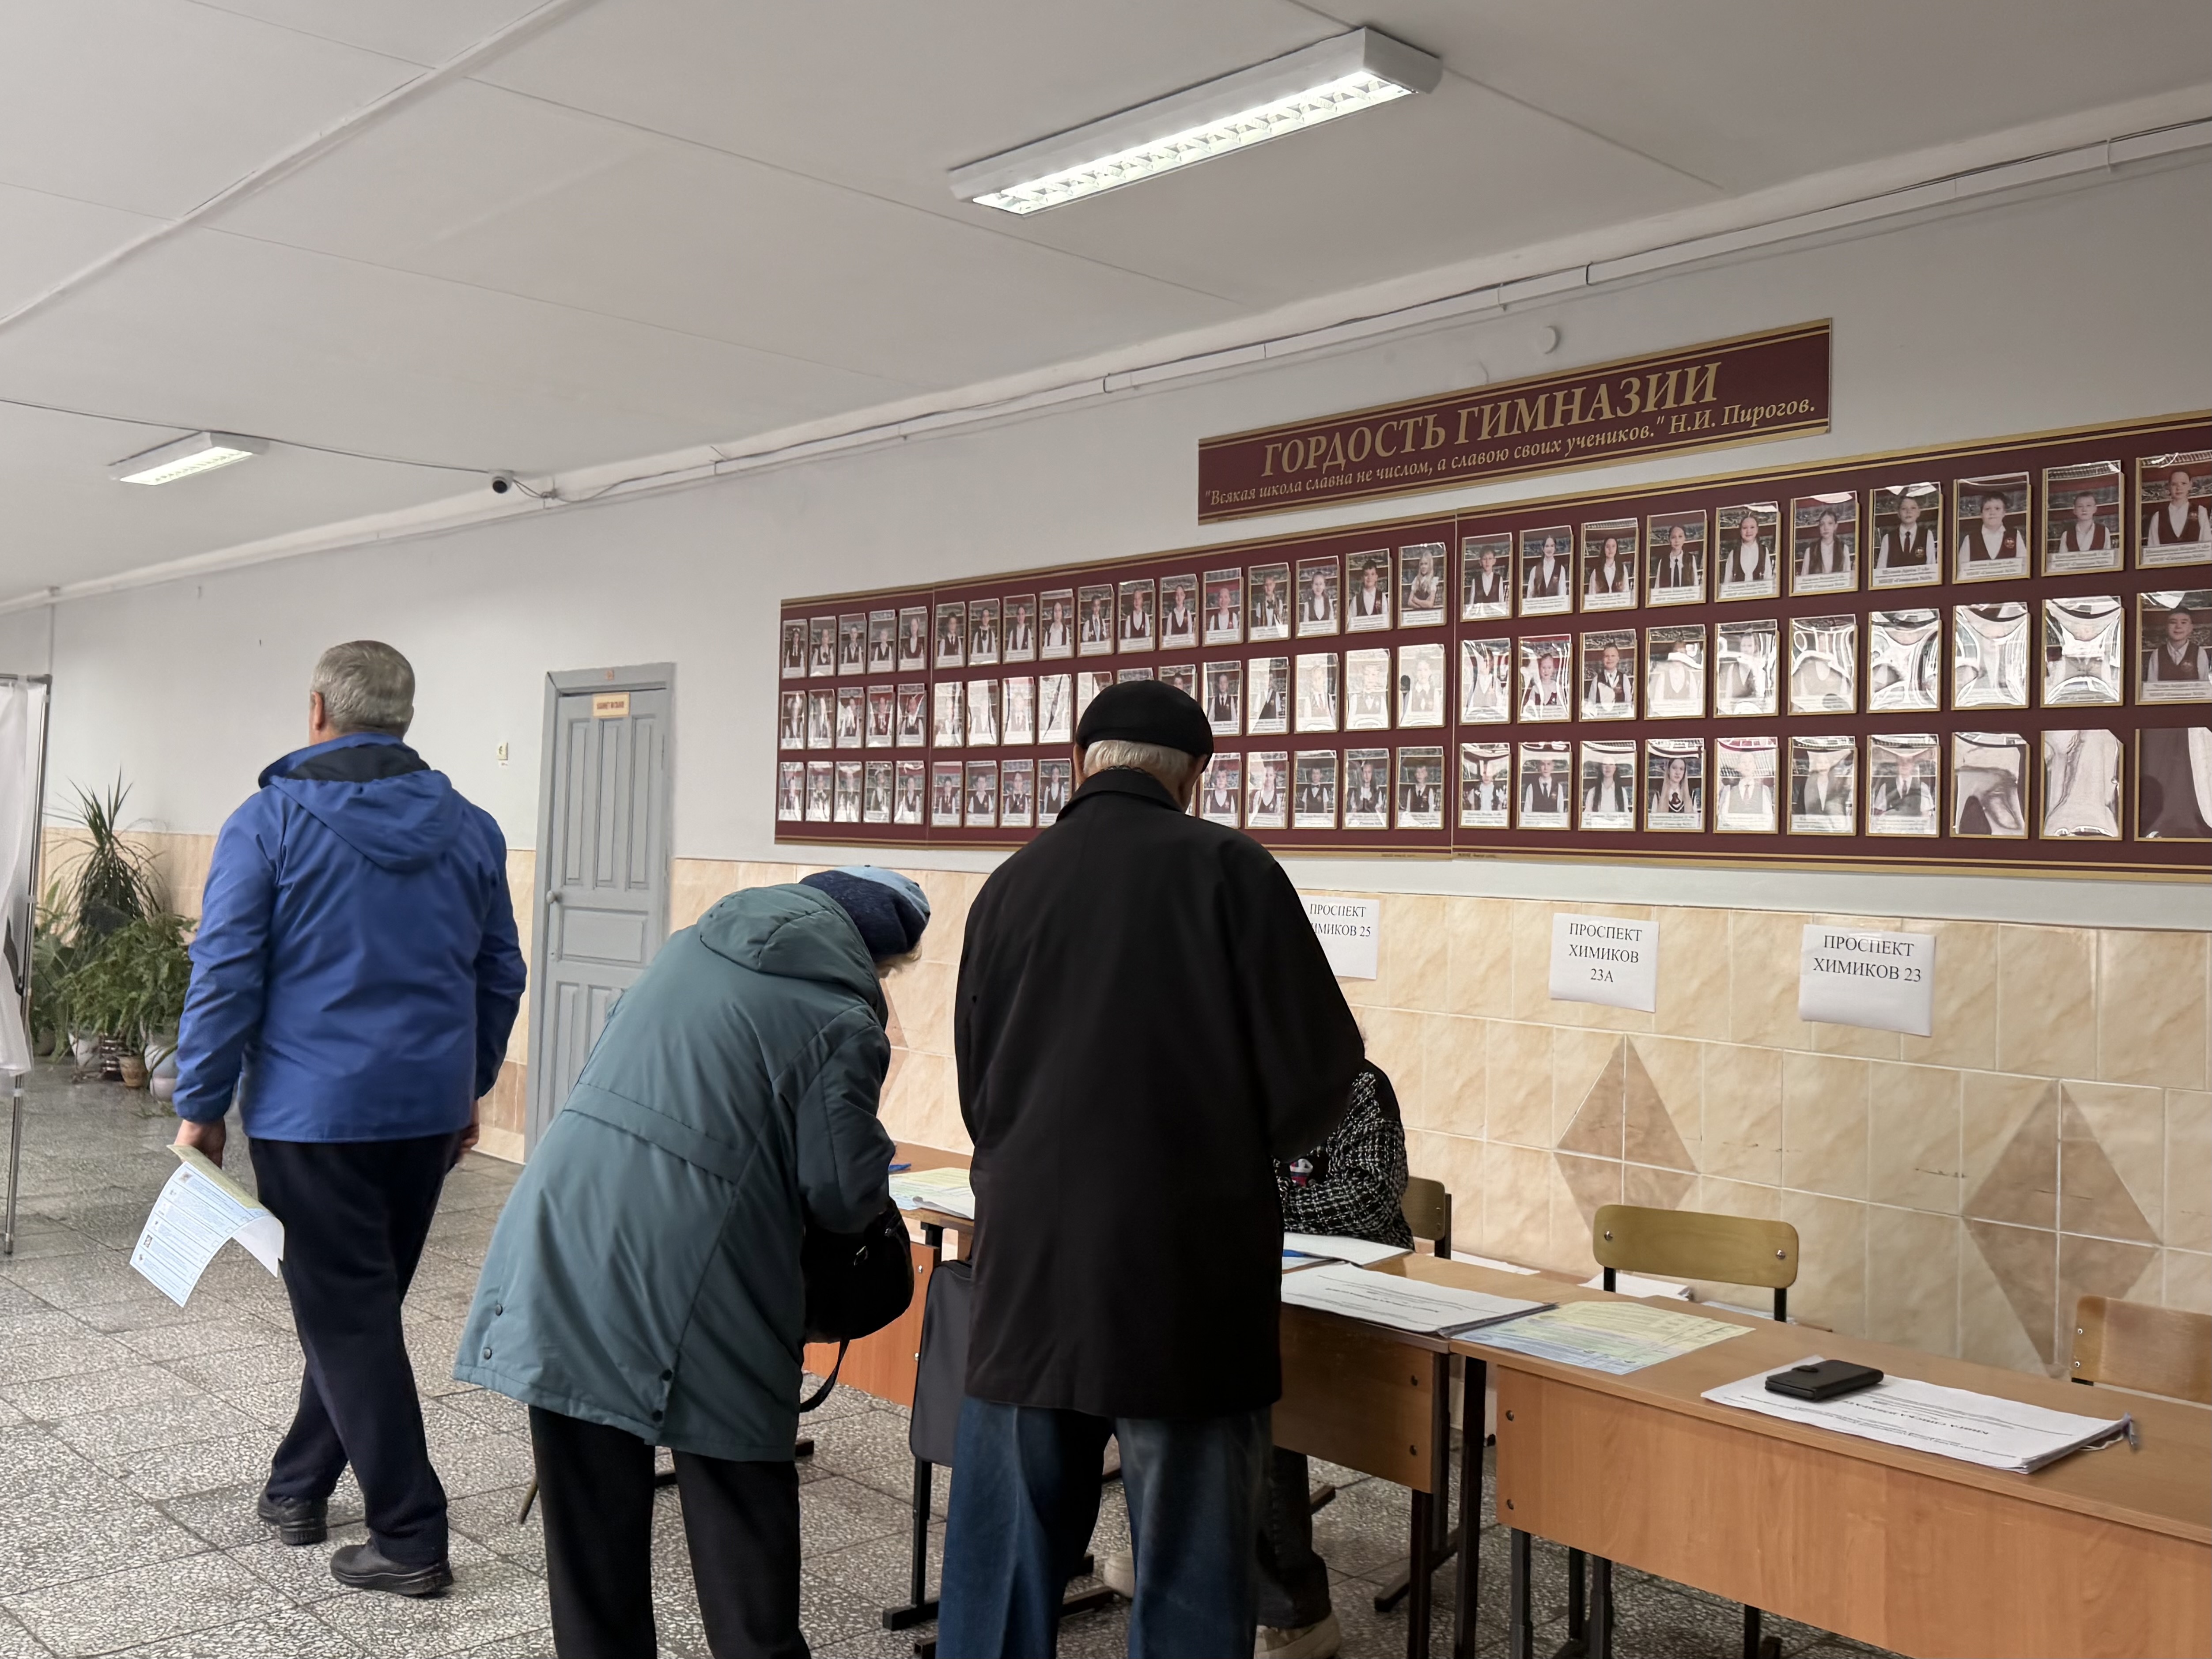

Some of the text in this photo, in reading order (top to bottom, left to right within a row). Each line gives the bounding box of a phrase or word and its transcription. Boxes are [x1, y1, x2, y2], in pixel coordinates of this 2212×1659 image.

[1261, 362, 1721, 477] ГОРДОСТЬ ГИМНАЗИИ
[1205, 488, 1255, 505] "Всякая
[1260, 480, 1302, 497] школа
[1306, 473, 1352, 490] славна
[1357, 469, 1372, 484] не
[1376, 462, 1432, 480] числом,
[1437, 459, 1446, 471] а
[1451, 448, 1509, 468] славою
[1514, 439, 1562, 458] своих
[1668, 410, 1715, 434] Н.И.
[1721, 399, 1815, 427] Пирогов.
[1310, 903, 1366, 917] ПРОСПЕКТ
[1311, 923, 1371, 937] ИМИКОВ 25
[1569, 923, 1642, 941] ПРОСПЕКТ
[1569, 944, 1639, 963] ХИМИКОВ
[1824, 935, 1914, 956] ПРОСПЕКТ
[1591, 968, 1613, 983] 23А
[1813, 958, 1921, 982] ХИМИКОВ 23
